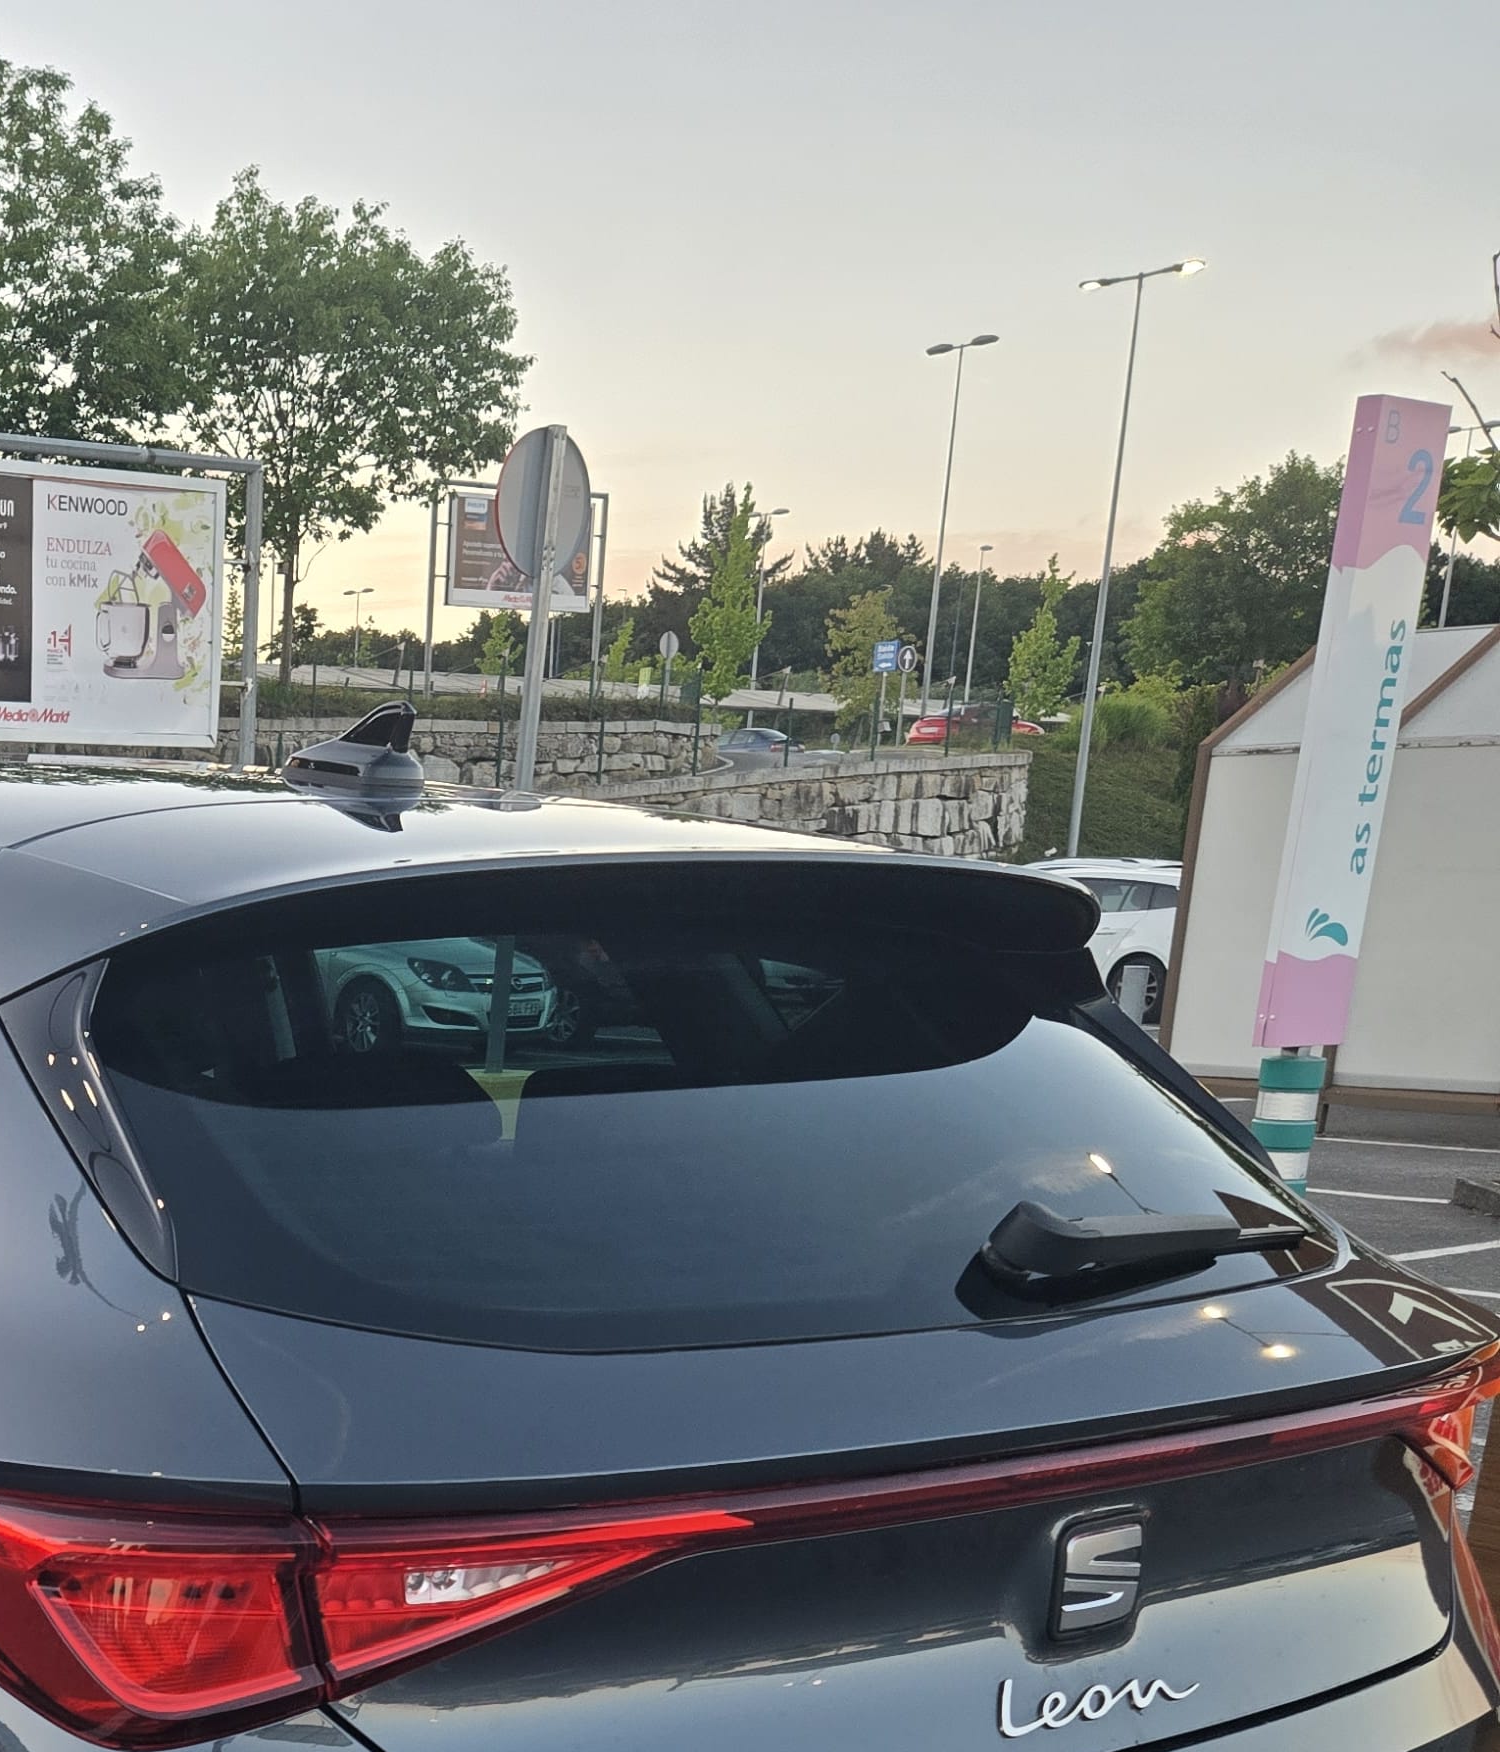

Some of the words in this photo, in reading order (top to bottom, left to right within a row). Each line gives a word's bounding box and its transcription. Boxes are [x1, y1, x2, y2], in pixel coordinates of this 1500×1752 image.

[47, 493, 127, 516] KENWOOD
[1398, 449, 1433, 525] 2
[46, 537, 112, 556] ENDULZA
[46, 555, 58, 568] tu
[60, 557, 97, 571] cocina
[45, 575, 66, 586] con
[68, 572, 99, 589] kMix
[1358, 619, 1407, 806] termas
[1350, 822, 1371, 875] as
[1001, 1679, 1200, 1737] Leon
